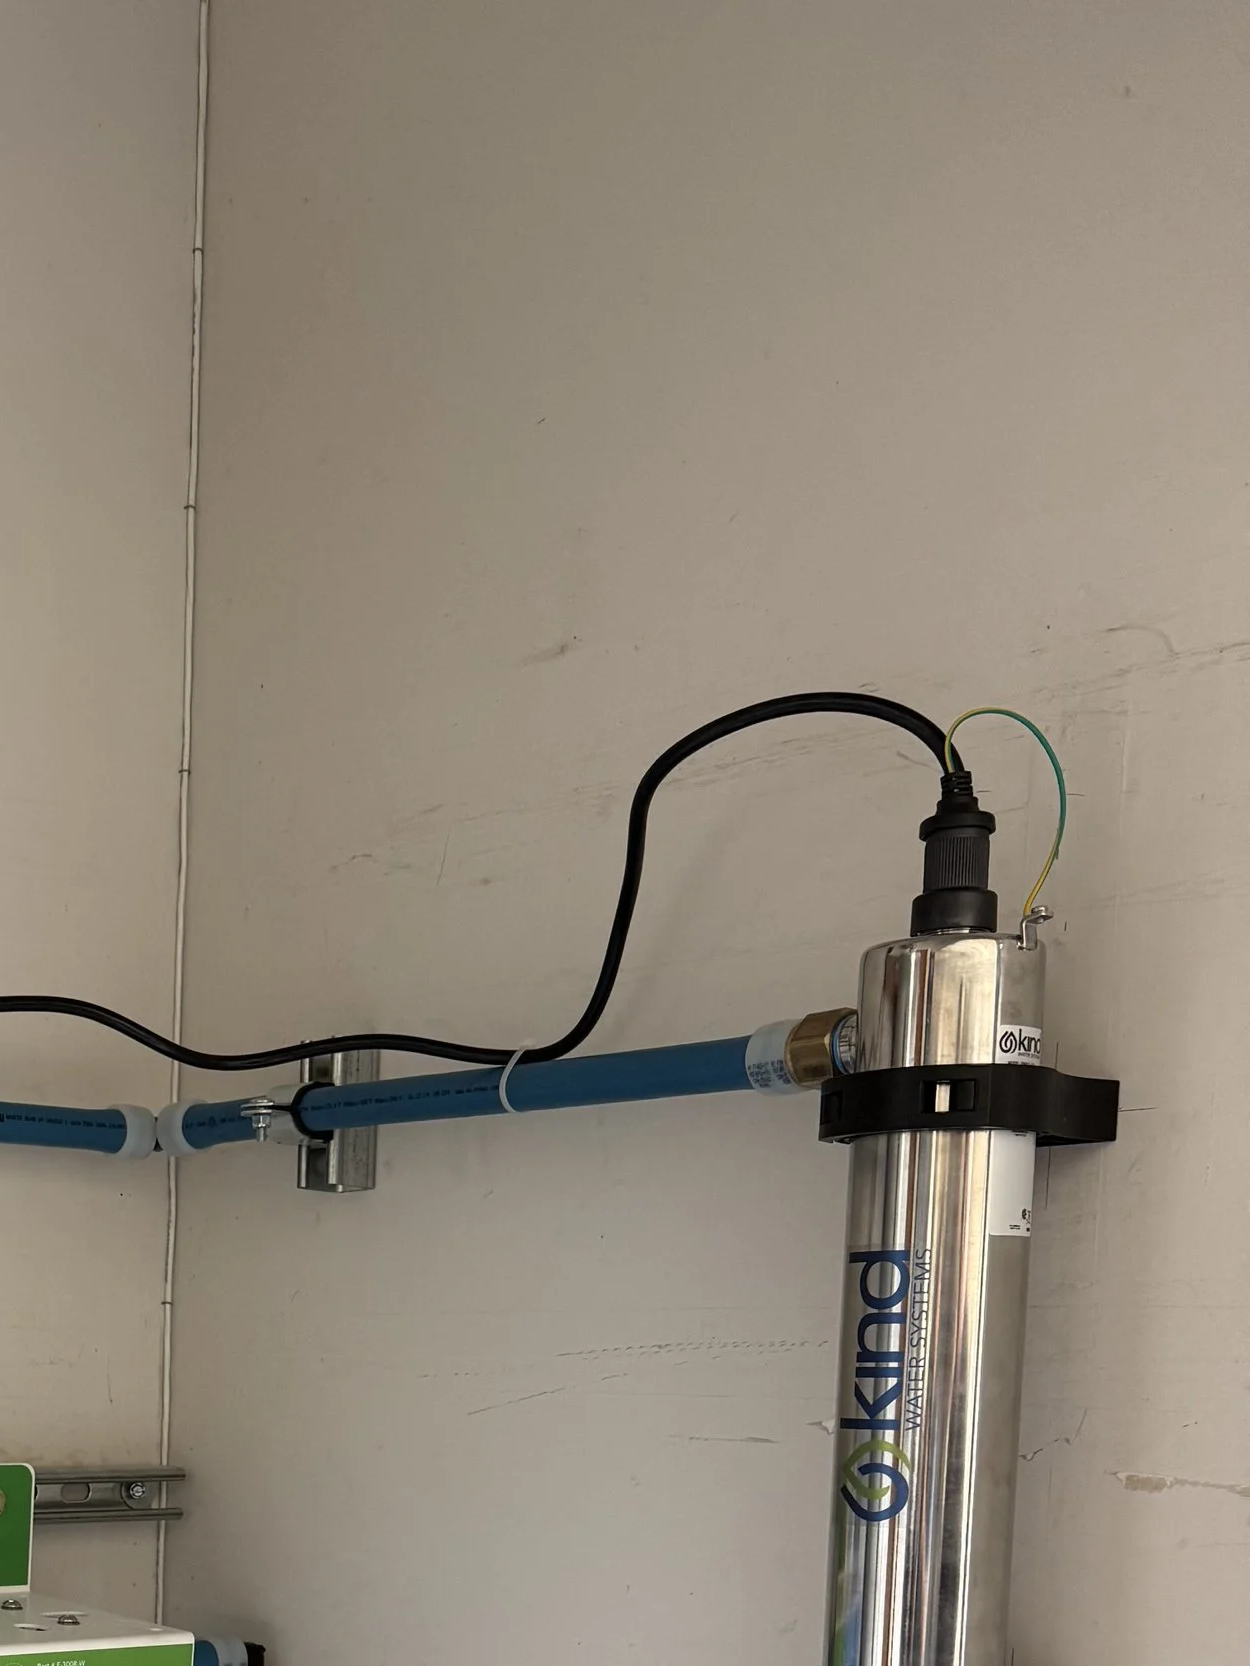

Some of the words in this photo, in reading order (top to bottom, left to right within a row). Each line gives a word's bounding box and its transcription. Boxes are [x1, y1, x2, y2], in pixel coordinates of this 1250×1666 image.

[840, 1249, 910, 1430] kind
[910, 1248, 932, 1348] SYSTEMS
[906, 1357, 926, 1431] WATER
